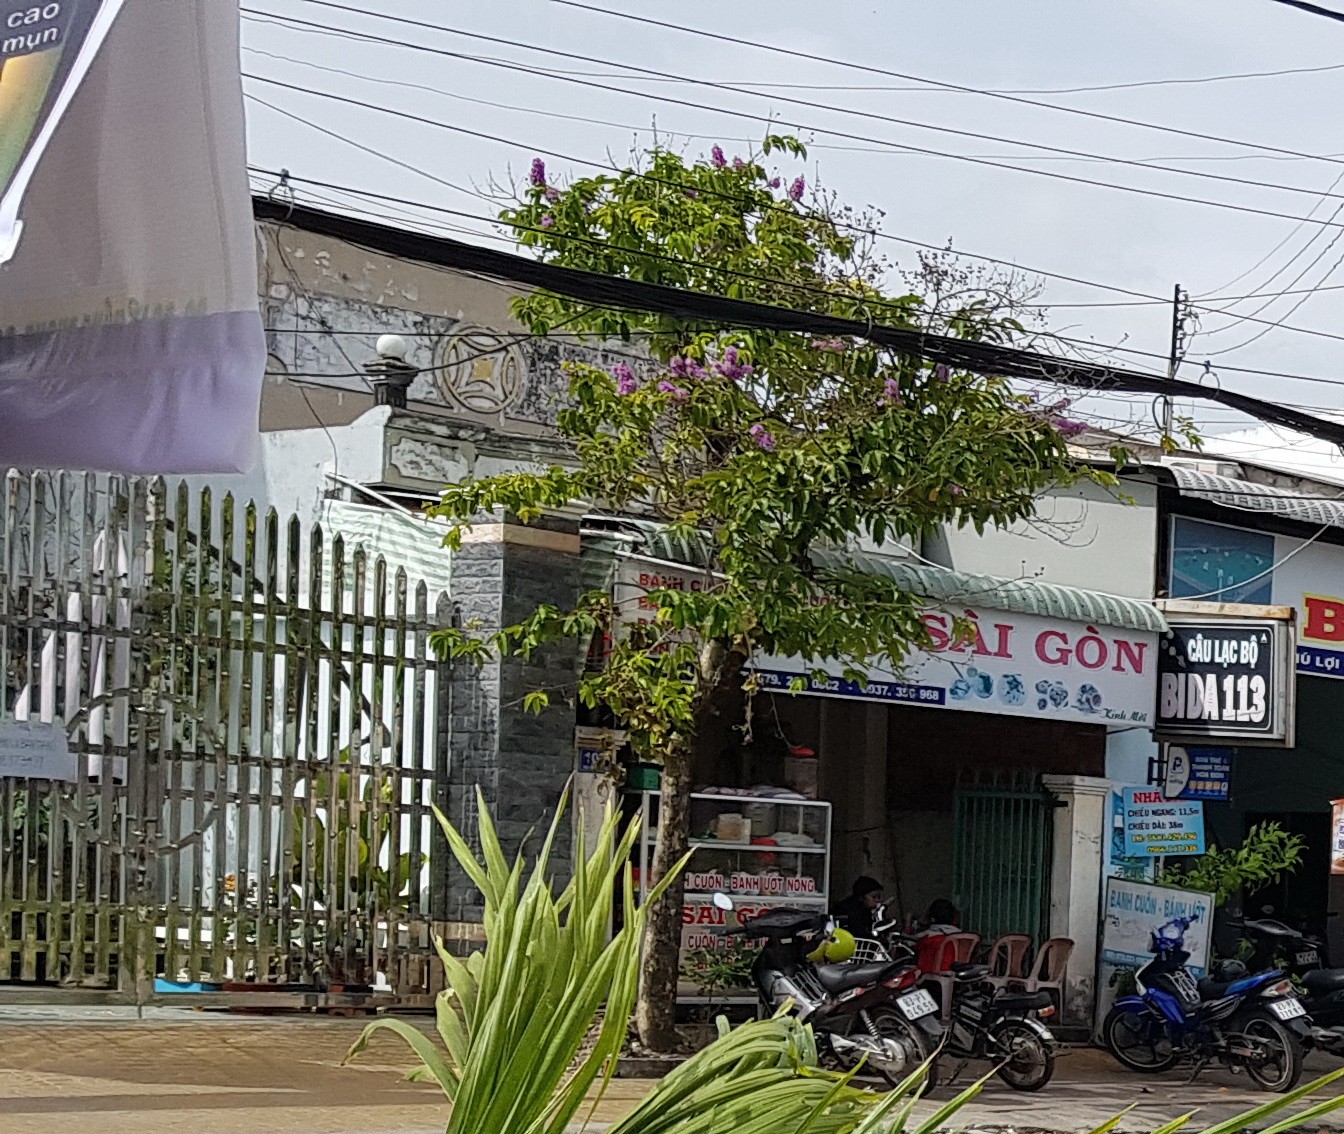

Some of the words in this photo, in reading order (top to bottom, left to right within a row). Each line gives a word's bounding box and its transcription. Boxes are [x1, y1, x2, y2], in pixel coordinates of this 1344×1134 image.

[7, 3, 60, 28] cao
[1, 27, 59, 52] mụn
[1034, 625, 1149, 675] GÒN
[1187, 632, 1212, 663] CÂU
[1214, 639, 1239, 669] LẠC
[1240, 634, 1259, 669] BỘ
[1315, 655, 1340, 671] LỢI
[1222, 674, 1266, 723] 113
